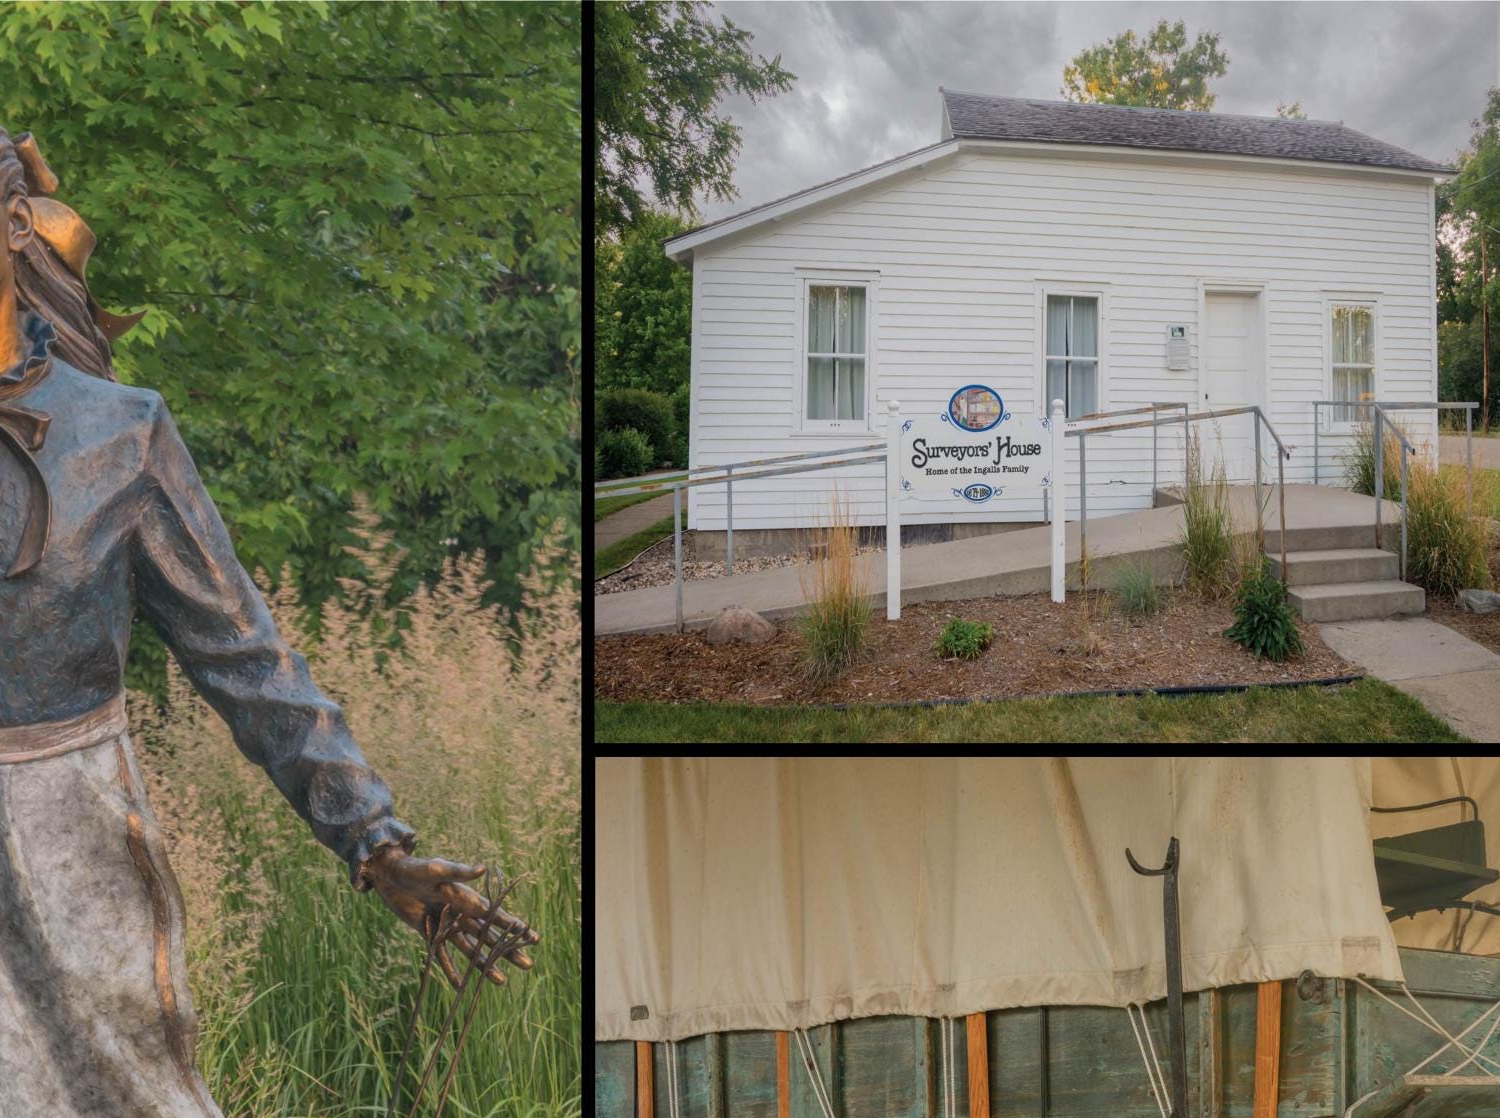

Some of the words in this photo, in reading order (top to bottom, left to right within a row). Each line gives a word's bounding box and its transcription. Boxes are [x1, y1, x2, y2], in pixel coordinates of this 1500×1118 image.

[911, 438, 992, 468] Surveyors'
[993, 436, 1041, 465] House
[950, 467, 958, 475] of
[959, 467, 972, 475] the
[974, 466, 1000, 476] Ingalls
[1002, 465, 1029, 475] Family
